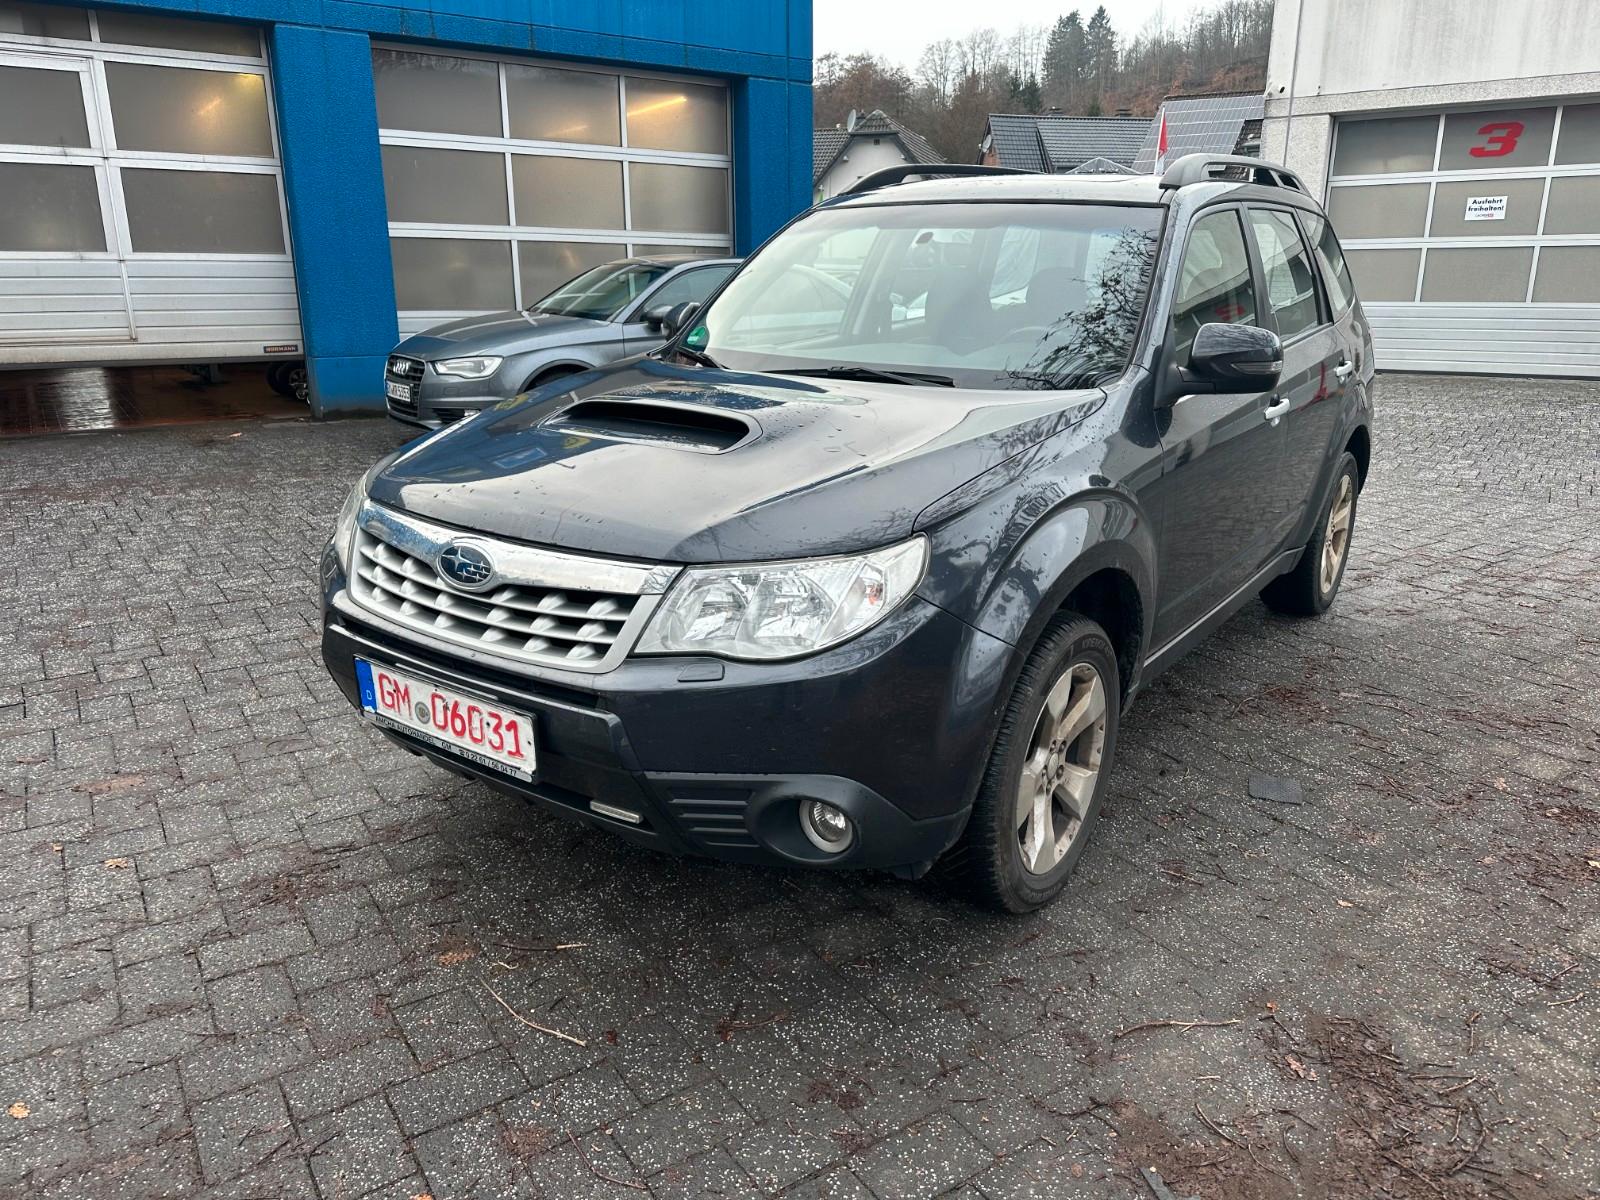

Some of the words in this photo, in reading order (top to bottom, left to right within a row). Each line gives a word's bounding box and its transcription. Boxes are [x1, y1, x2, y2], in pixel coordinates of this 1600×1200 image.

[1469, 121, 1525, 158] 3
[366, 690, 373, 700] D
[378, 673, 412, 718] GM
[431, 693, 524, 758] 06031
